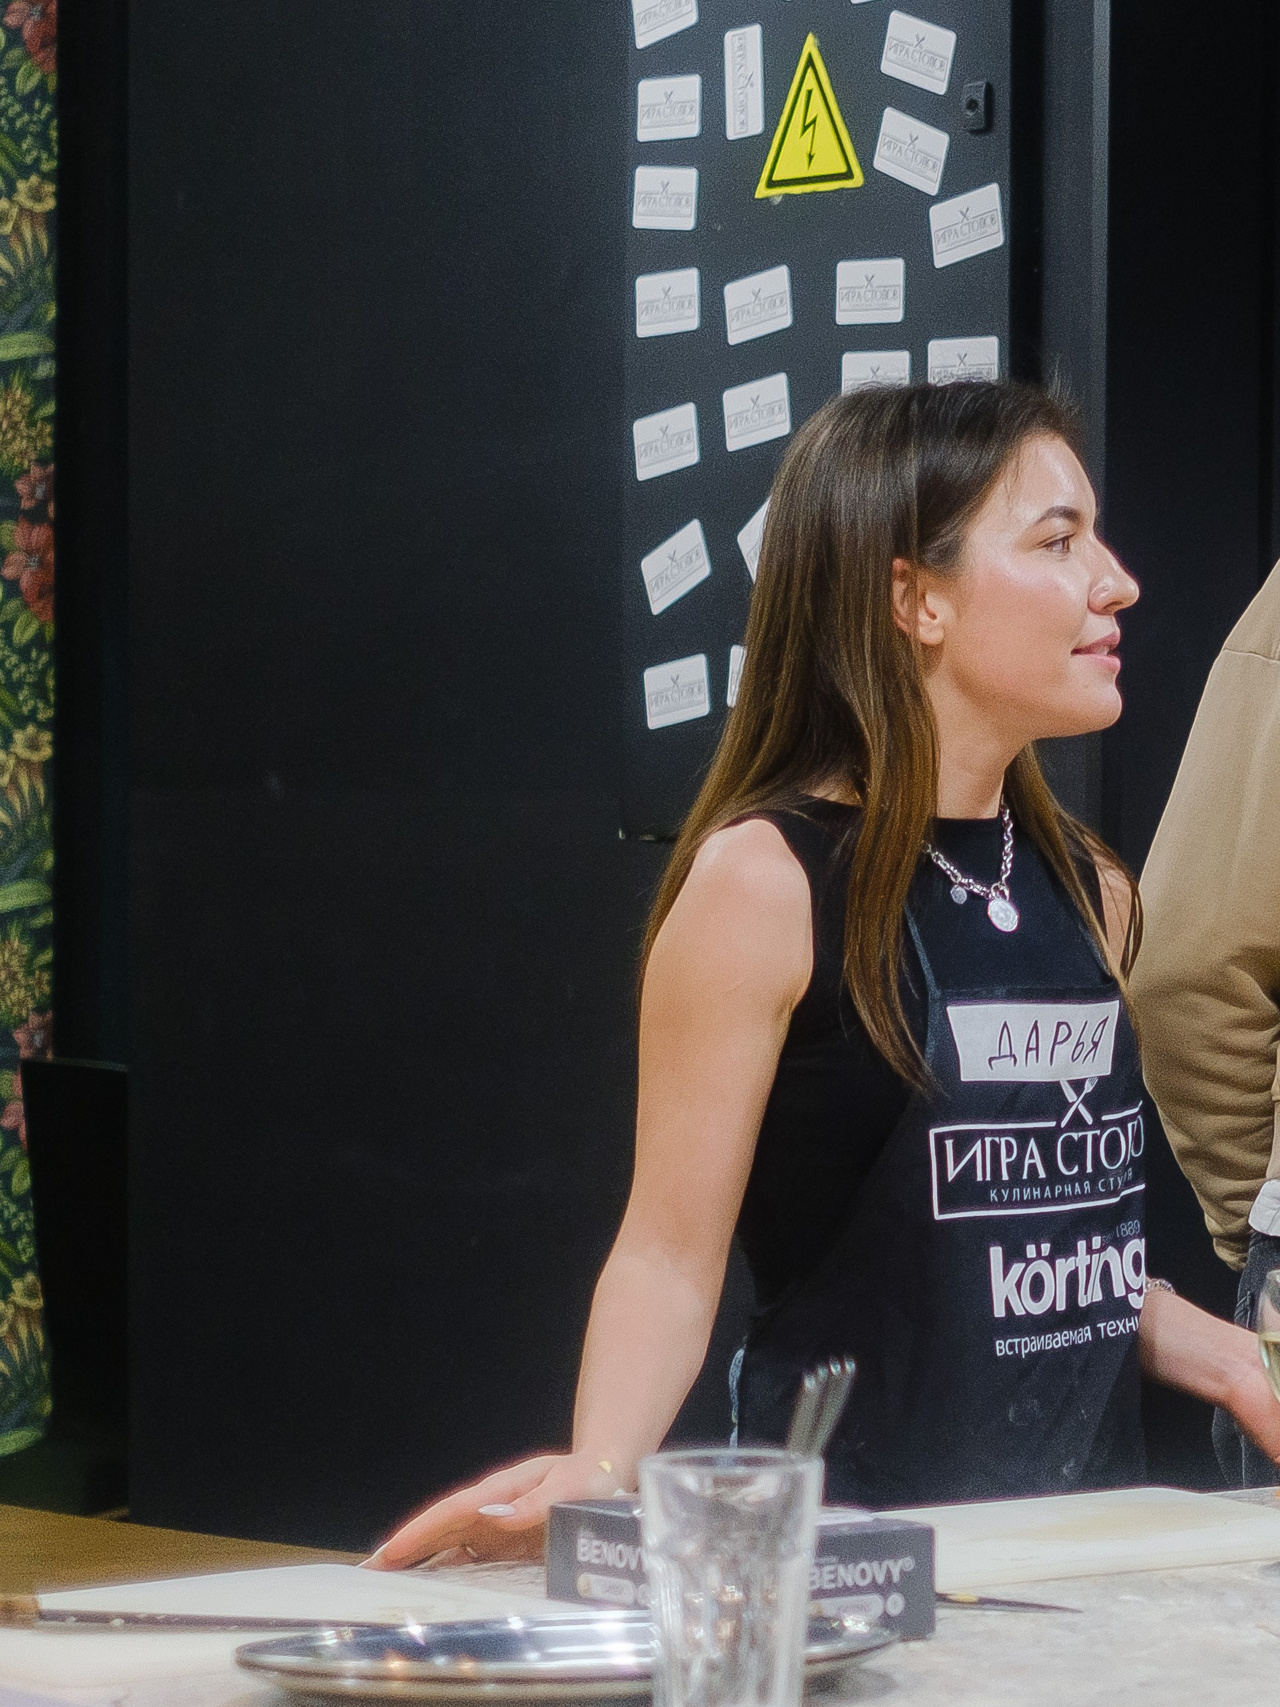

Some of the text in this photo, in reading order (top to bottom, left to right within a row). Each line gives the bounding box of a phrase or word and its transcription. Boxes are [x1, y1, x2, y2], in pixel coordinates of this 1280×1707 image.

[988, 1015, 1109, 1071] ДАРЬЯ
[944, 1135, 1046, 1183] ИГРА
[990, 1180, 1091, 1204] КУЛИНАРНАЯ
[989, 1235, 1146, 1319] körting
[994, 1325, 1092, 1359] встраиваемая
